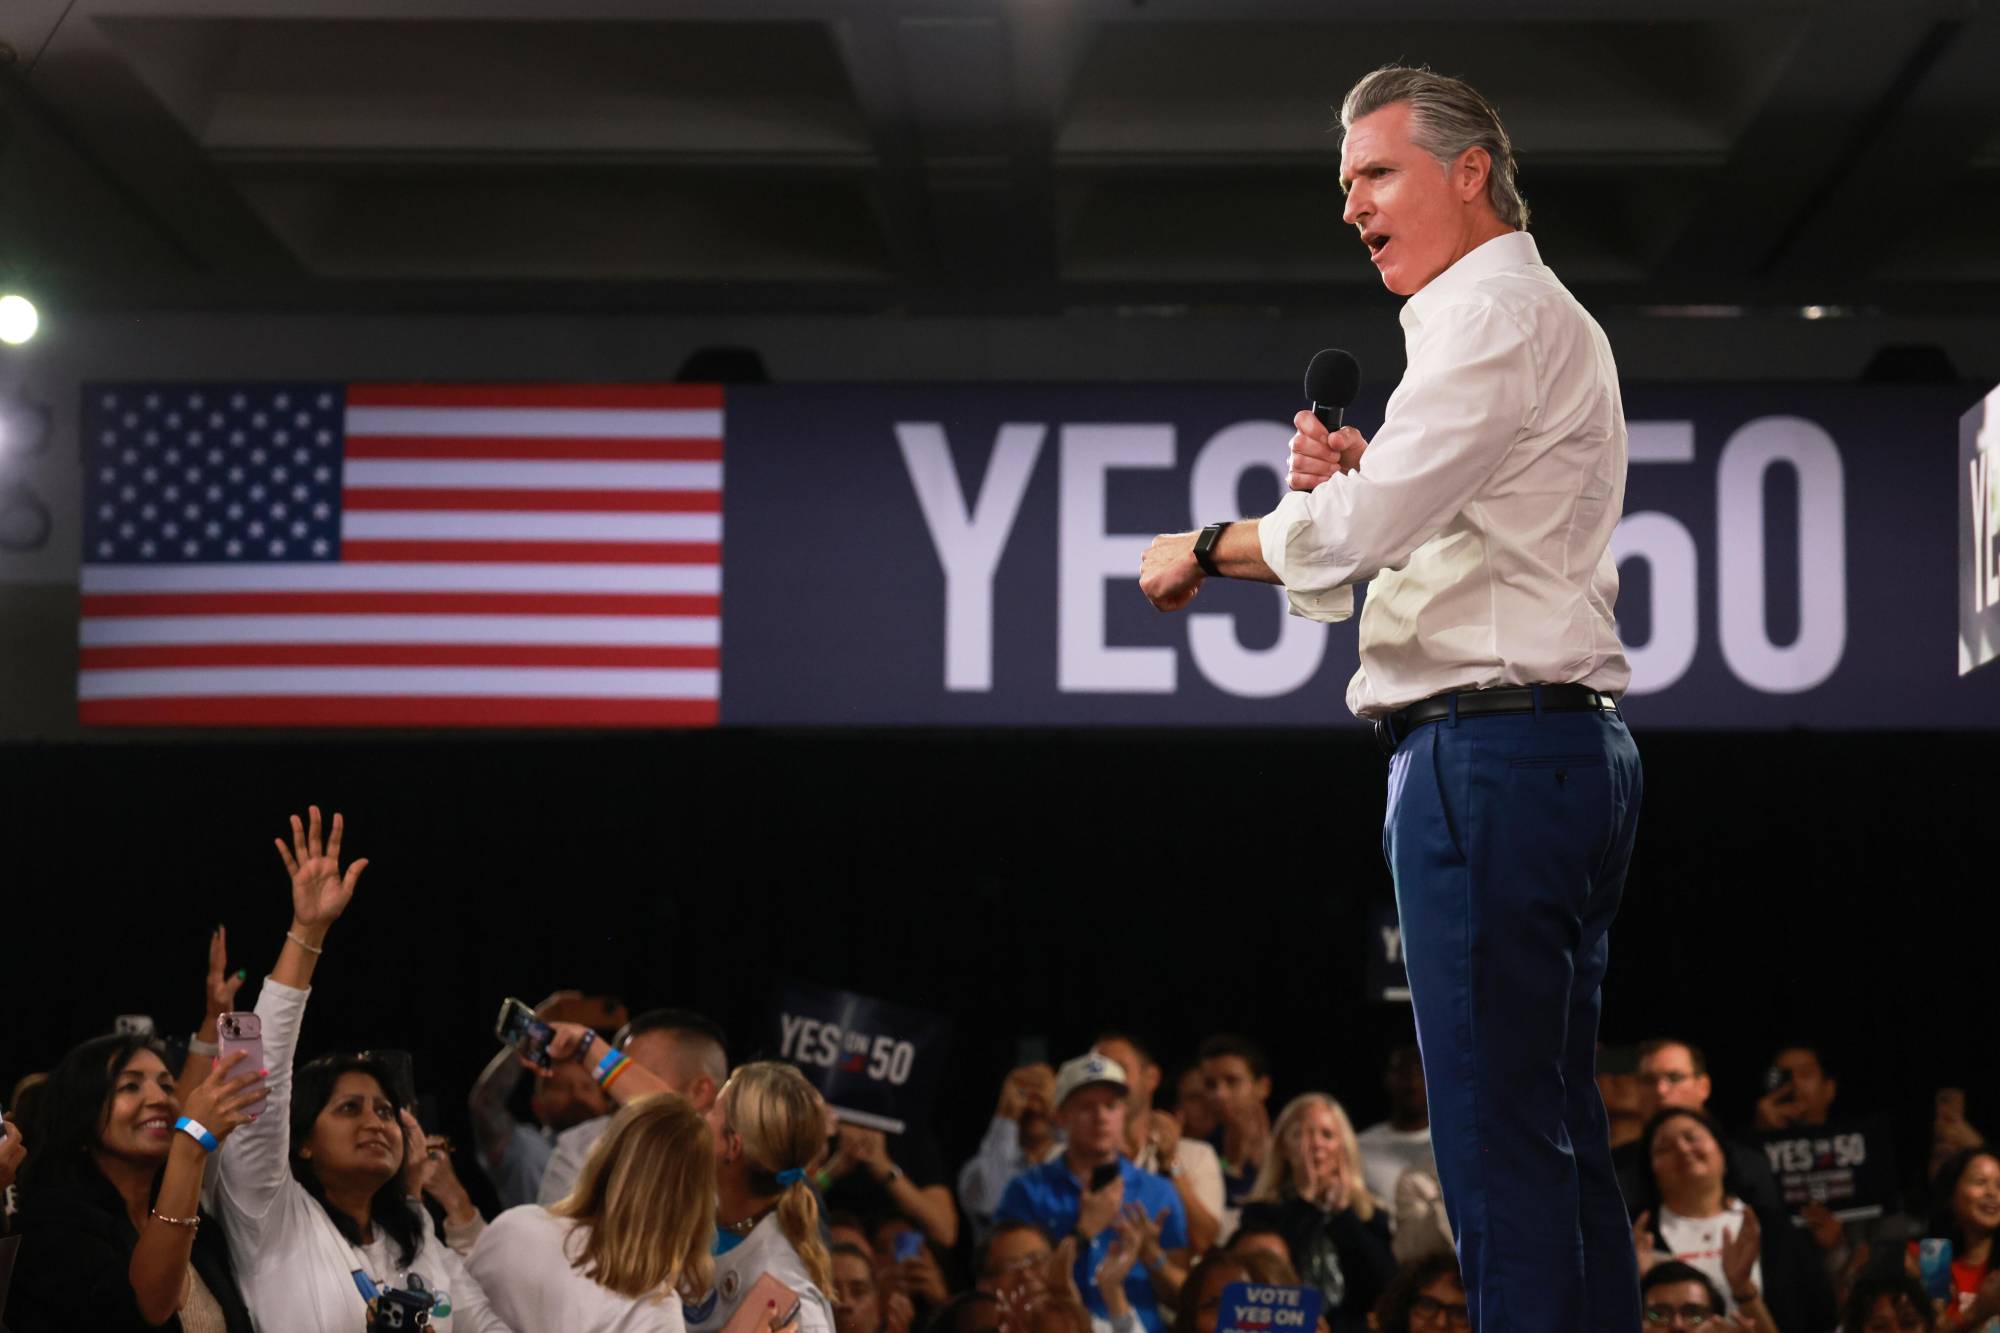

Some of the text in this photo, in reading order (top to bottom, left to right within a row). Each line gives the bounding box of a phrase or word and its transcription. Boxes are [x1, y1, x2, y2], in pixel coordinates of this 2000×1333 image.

[895, 421, 1328, 696] YES
[781, 1013, 841, 1067] YES
[868, 1036, 914, 1084] 50
[1764, 1140, 1813, 1173] YES
[1246, 1287, 1299, 1306] VOTE
[1234, 1305, 1304, 1327] YES ON
